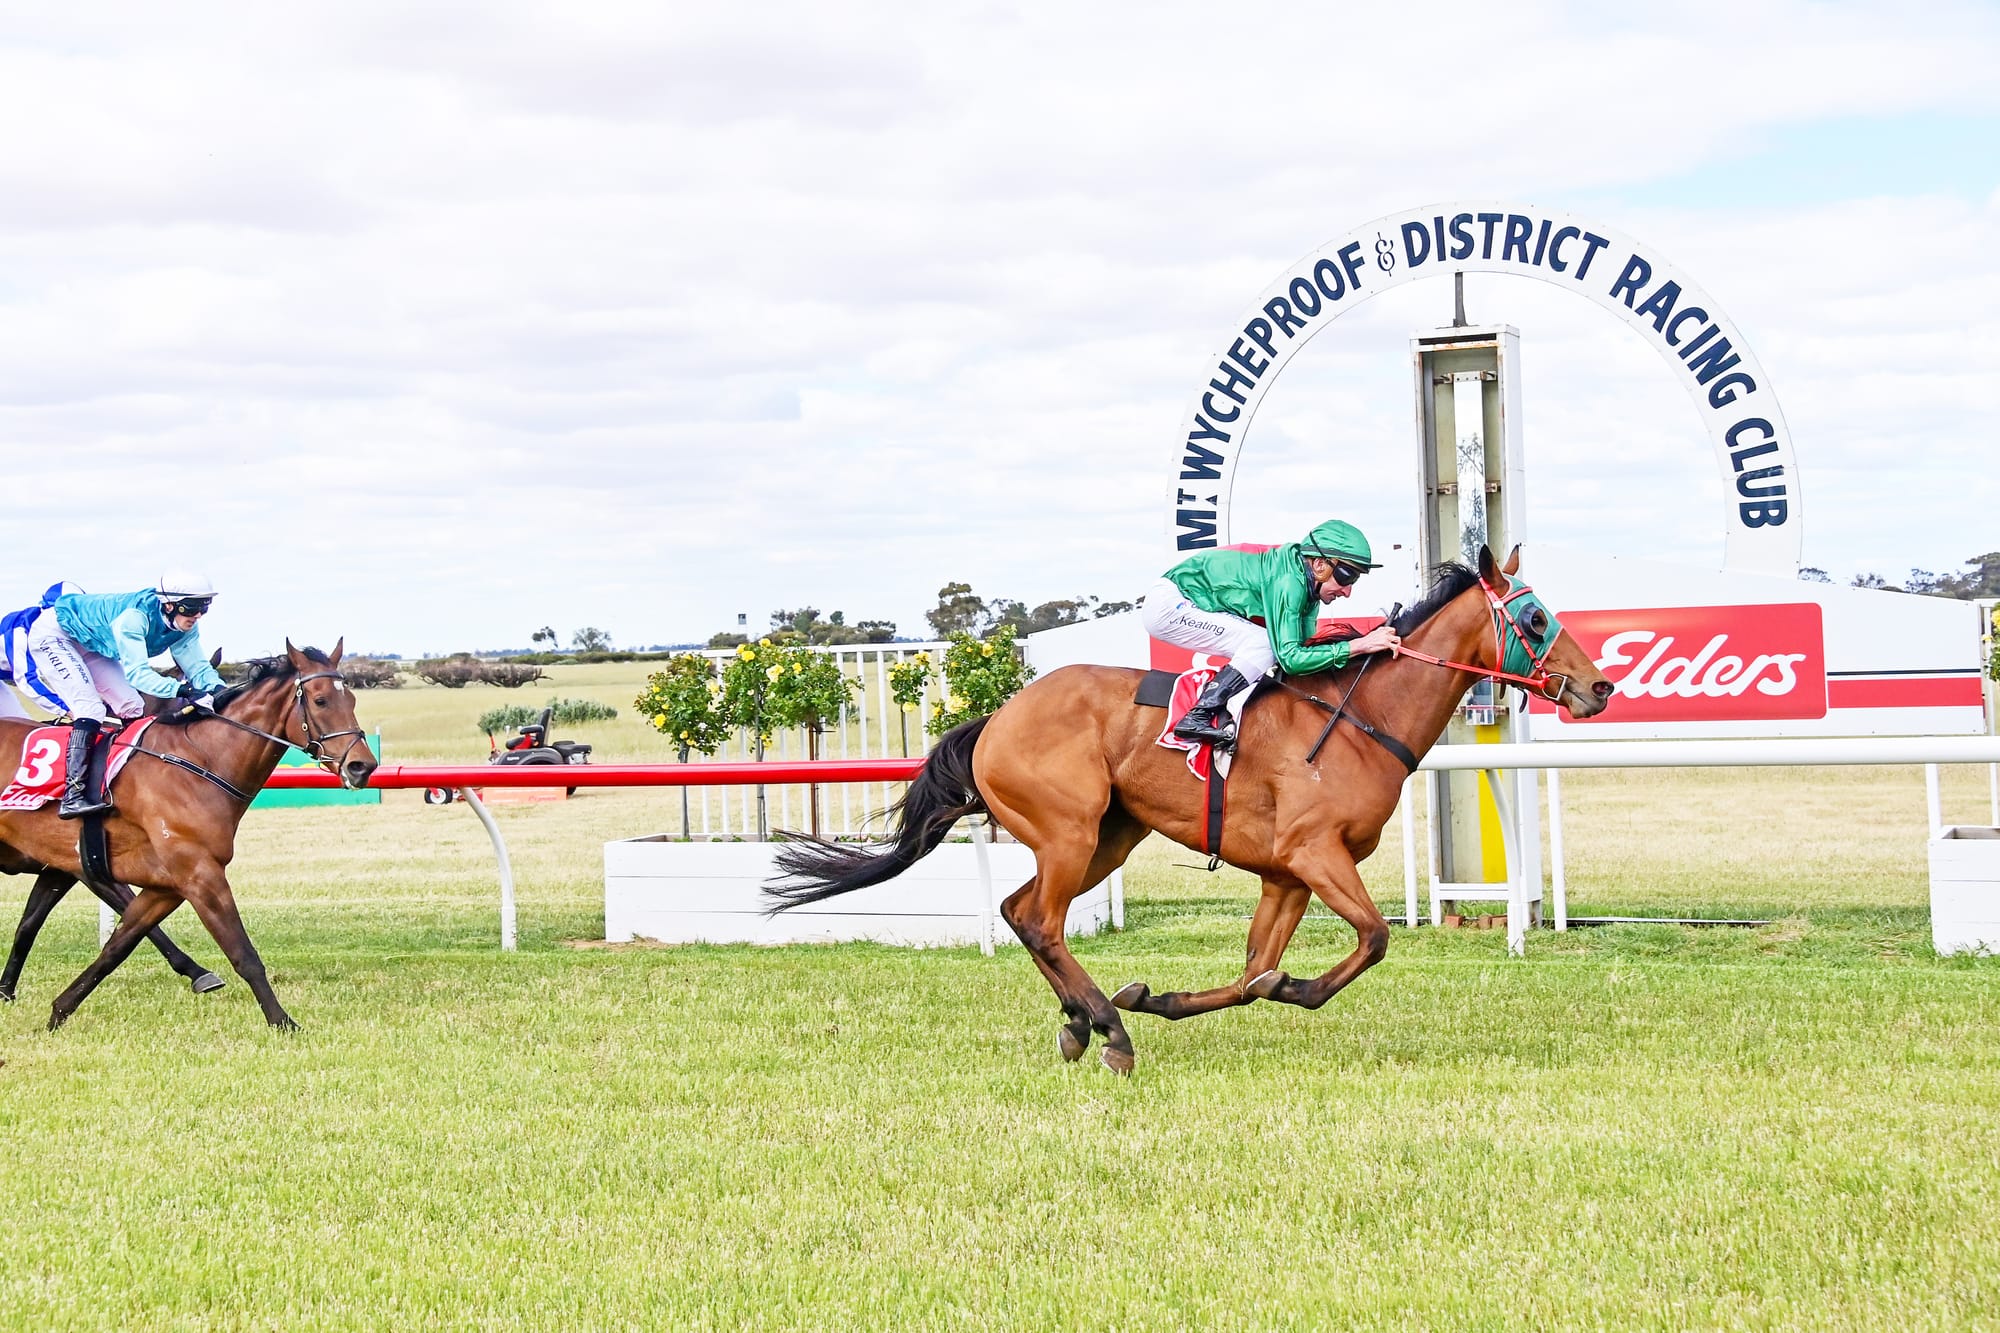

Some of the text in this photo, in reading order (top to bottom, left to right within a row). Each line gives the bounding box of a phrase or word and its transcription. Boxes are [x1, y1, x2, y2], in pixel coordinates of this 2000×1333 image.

[1179, 240, 1366, 480] WYCHEPROOF
[1375, 232, 1396, 277] &
[1400, 212, 1610, 281] DISTRICT
[1608, 254, 1757, 410] RACING
[1725, 417, 1788, 529] CLUB
[1593, 630, 1807, 699] Elders
[15, 738, 60, 787] 3
